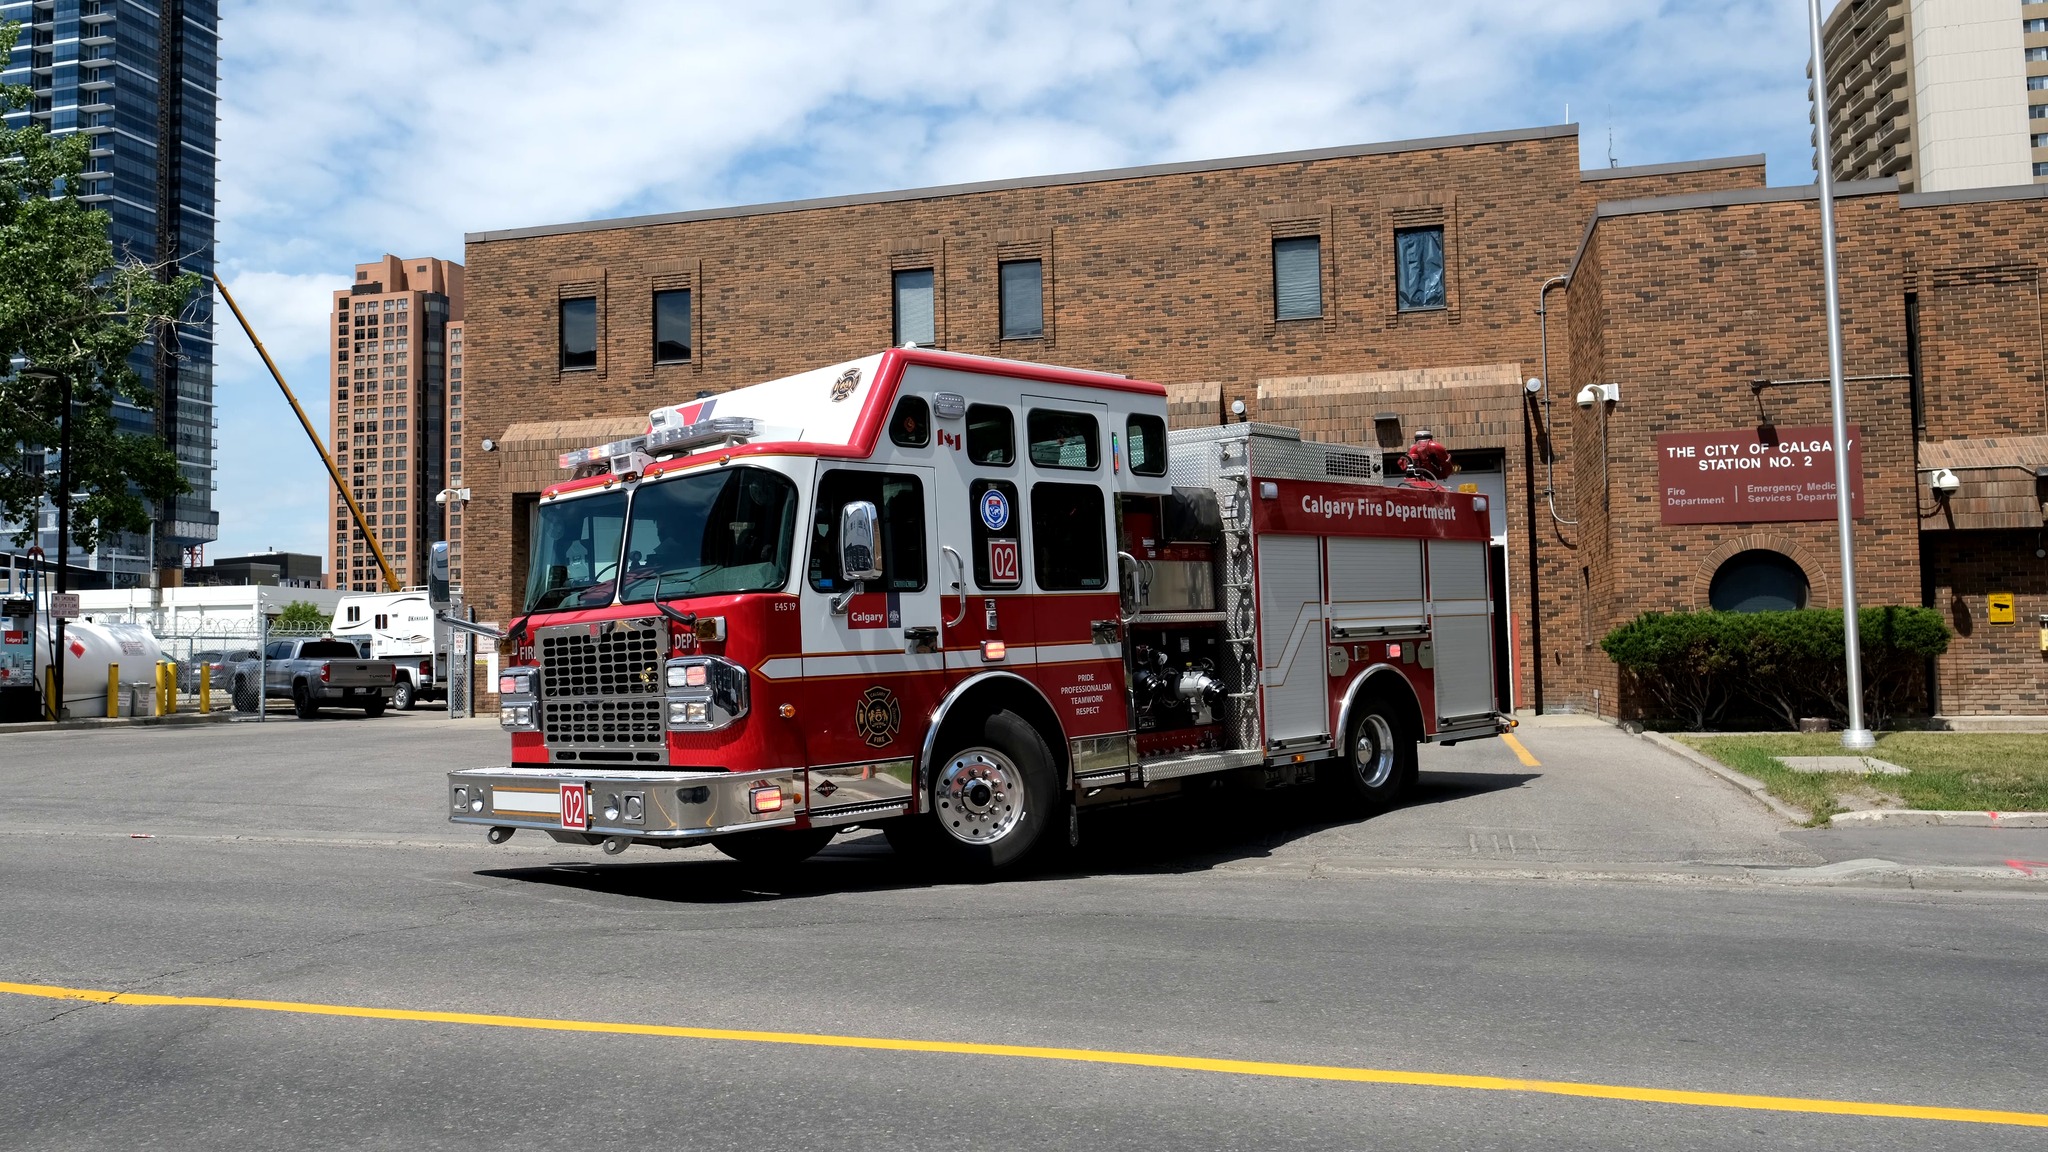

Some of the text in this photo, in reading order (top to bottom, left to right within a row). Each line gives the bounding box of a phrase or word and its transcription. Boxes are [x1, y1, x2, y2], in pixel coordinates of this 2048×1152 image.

[1666, 439, 1853, 458] THE CITY OF CALGAY
[1698, 455, 1813, 471] STATION NO. 2
[1667, 487, 1686, 496] Fire
[1747, 482, 1836, 494] Emergency Medic
[1667, 496, 1725, 507] Department
[1748, 491, 1855, 503] Services Departmt
[1301, 495, 1456, 522] Calgary Fire Department
[994, 547, 1014, 577] 02
[851, 612, 883, 624] Calgary
[1077, 673, 1095, 682] PRIDE
[1060, 683, 1112, 695] PROFESSIONALISM
[1070, 695, 1104, 705] TEAMWORK
[1075, 706, 1100, 716] RESPECT
[873, 735, 885, 743] FIRE
[564, 790, 583, 824] 02
